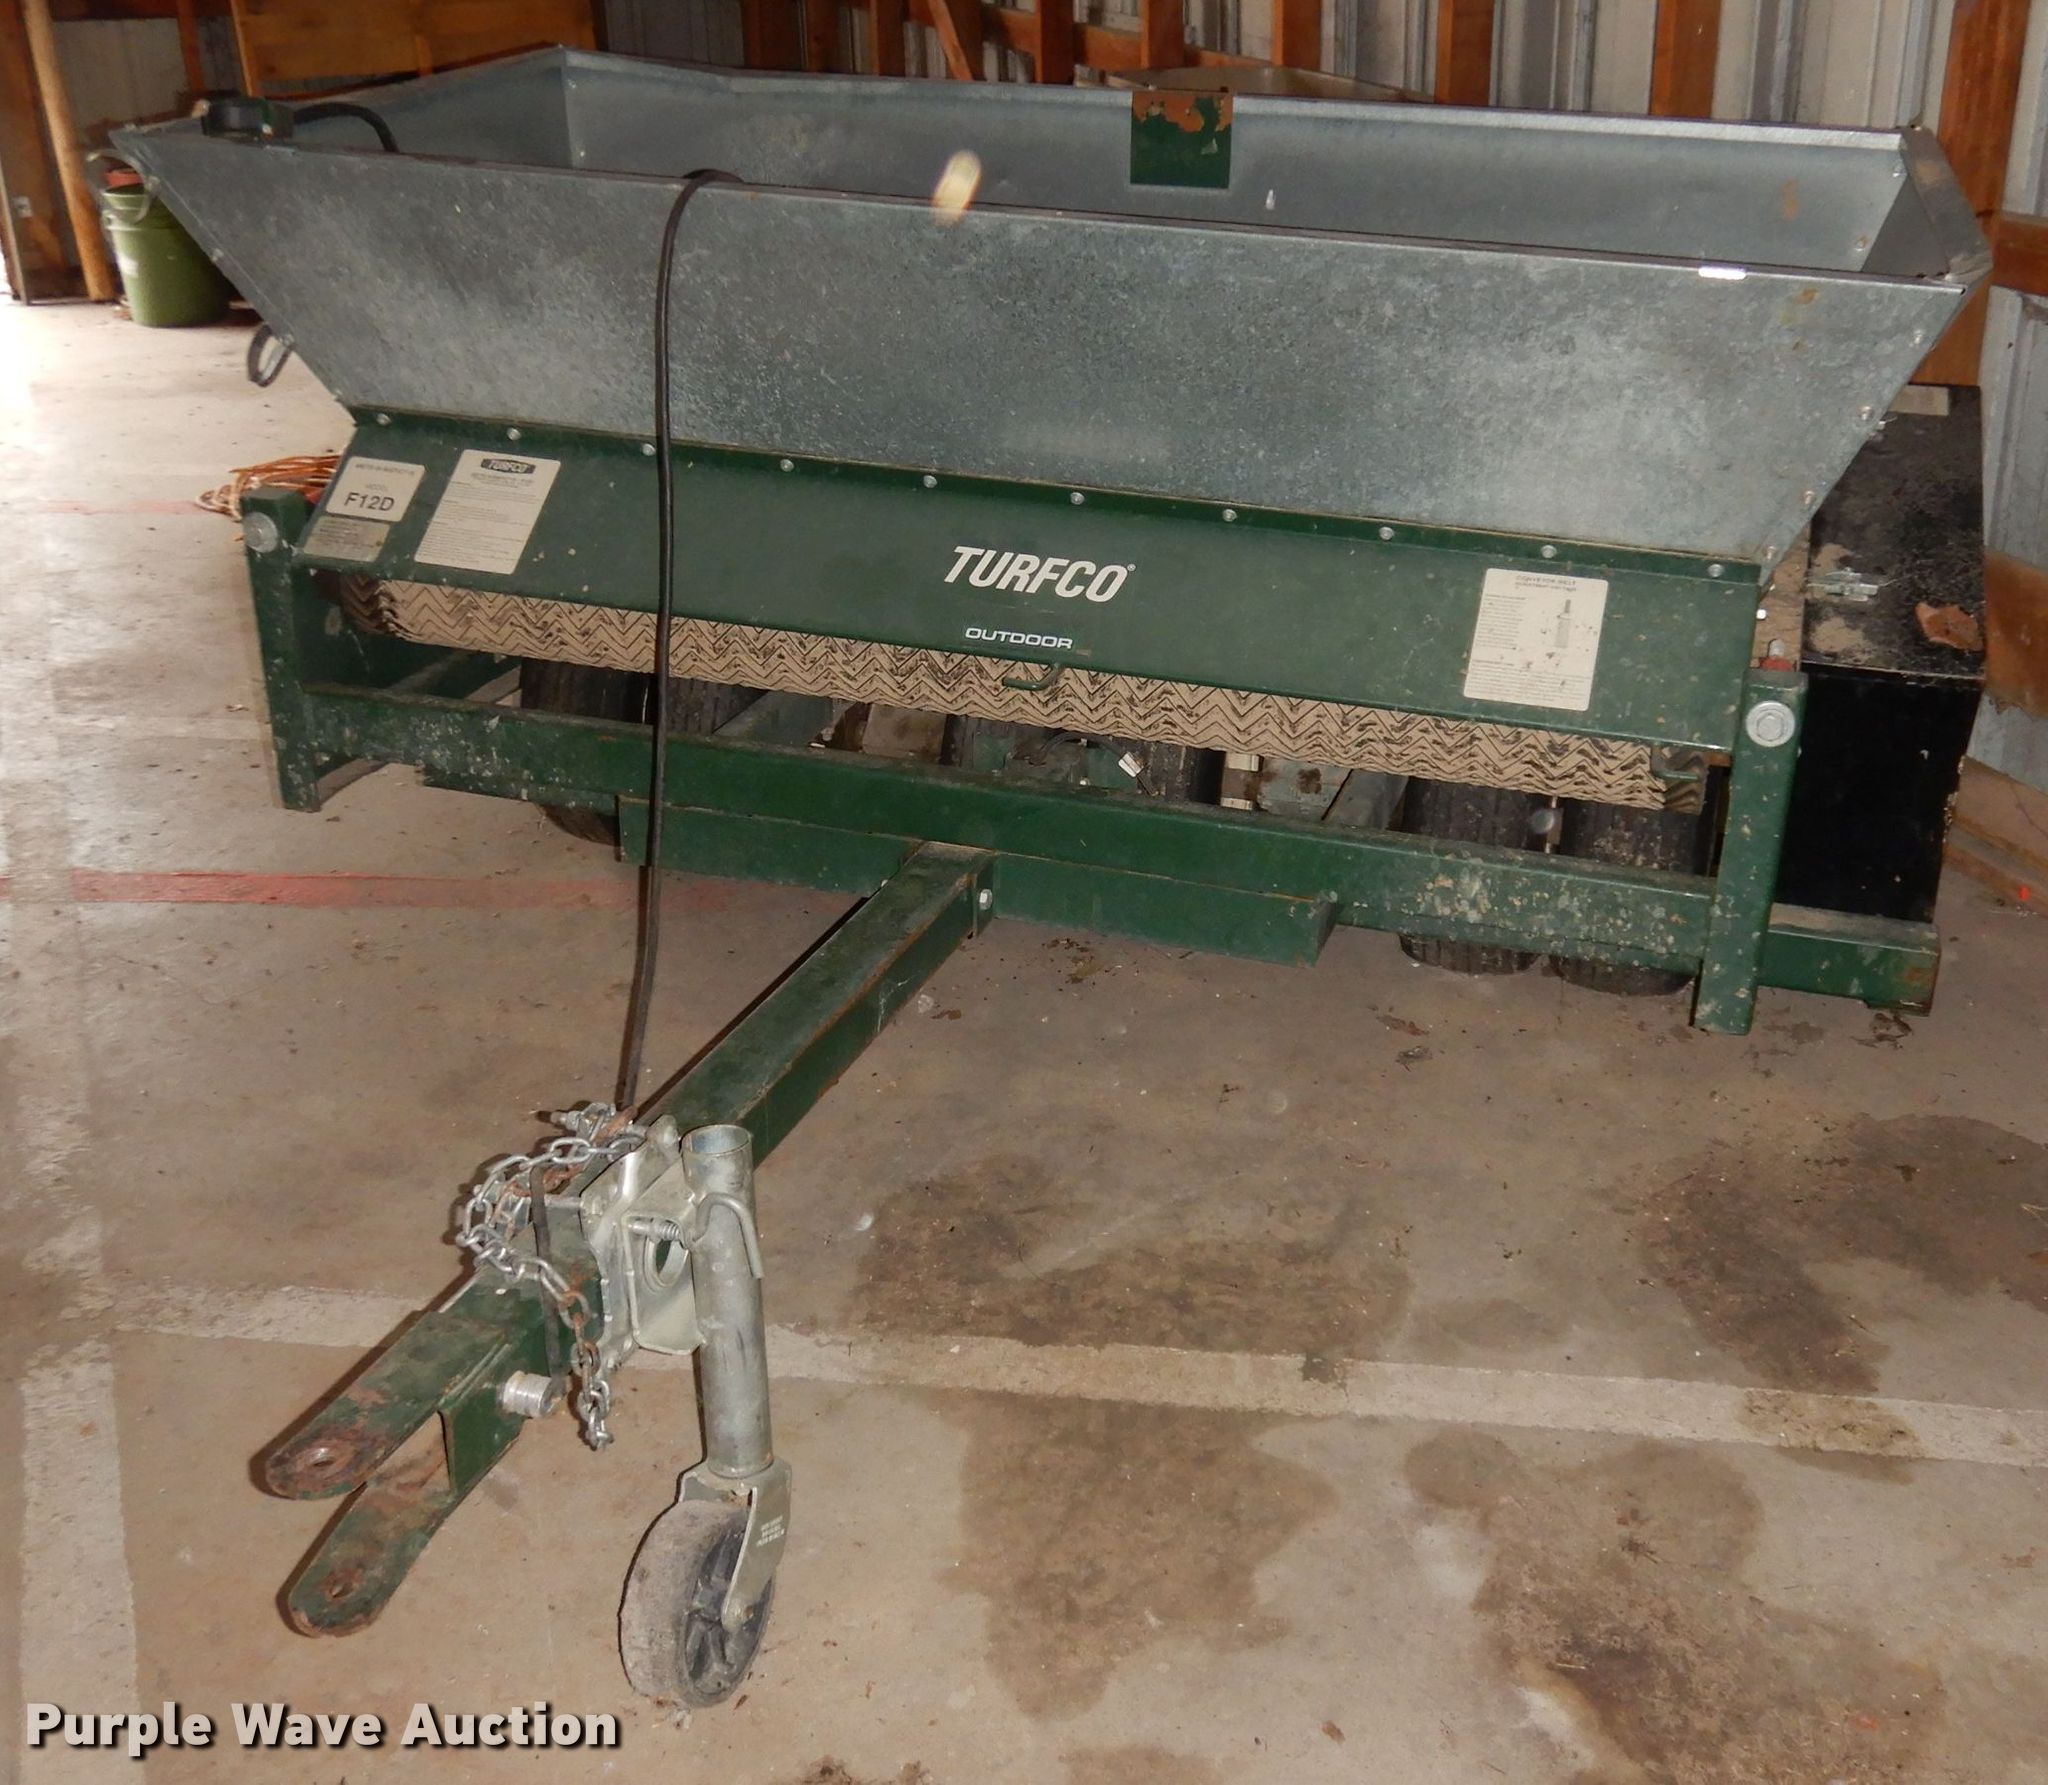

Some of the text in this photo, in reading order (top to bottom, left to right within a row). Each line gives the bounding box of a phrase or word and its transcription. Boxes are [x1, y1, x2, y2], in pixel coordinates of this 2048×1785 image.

[344, 491, 395, 511] F12D
[944, 545, 1129, 603] TURFCO
[965, 627, 1073, 650] OUTDOOR
